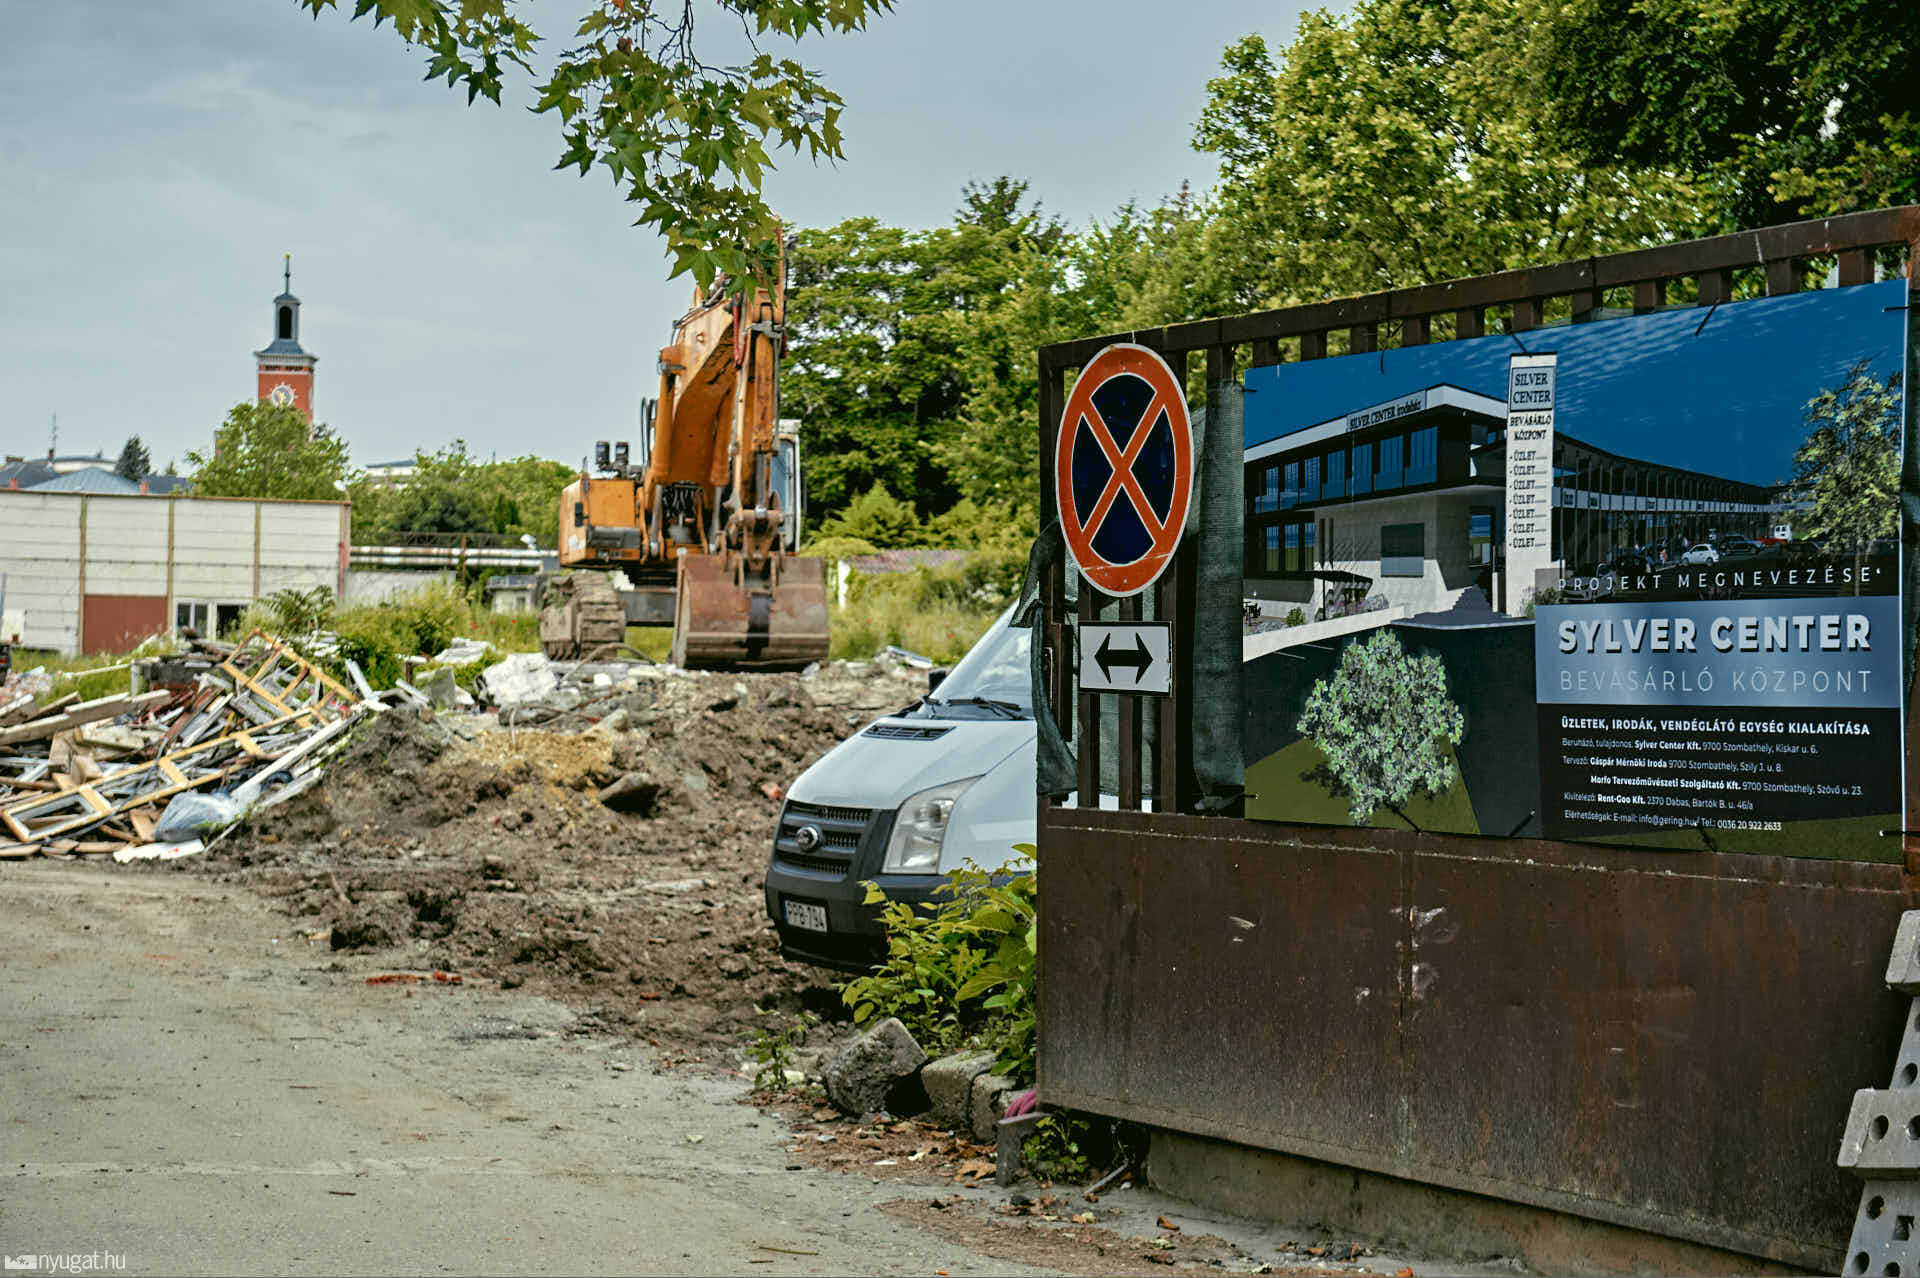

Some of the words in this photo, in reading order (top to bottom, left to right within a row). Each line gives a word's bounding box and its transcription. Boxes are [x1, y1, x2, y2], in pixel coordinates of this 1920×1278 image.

[1515, 373, 1548, 386] SILVER
[1513, 390, 1551, 404] CENTER
[1371, 406, 1396, 424] CENTER
[1558, 574, 1662, 591] PROJEKT
[1558, 618, 1696, 654] SYLVER
[1710, 614, 1872, 653] CENTER
[1733, 666, 1872, 692] KÖZPONT
[1562, 716, 1609, 730] ÜZLETEK,
[1612, 717, 1656, 732] IRODÁK,
[1660, 718, 1735, 732] VENDÉGLÁTÓ
[1740, 720, 1784, 733] EGYSÉG
[1788, 720, 1870, 734] KIALAKÍTÁSA
[1634, 740, 1657, 750] Sylver
[1659, 740, 1685, 750] Center
[1687, 740, 1702, 750] Kft.
[1702, 742, 1721, 751] 9700
[1723, 742, 1774, 754] Szombathely,
[1802, 746, 1809, 754] u.
[1810, 745, 1818, 754] 6.
[1590, 757, 1614, 768] Gáspár
[1616, 758, 1646, 768] Mérnöki
[1648, 760, 1667, 768] Iroda
[1669, 760, 1688, 769] 9700
[1688, 760, 1739, 772] Szombathely,
[1767, 764, 1774, 772] u.
[1776, 764, 1784, 772] 8.
[1590, 776, 1611, 784] Morfo
[1680, 779, 1724, 790] Szolgáltató
[1726, 780, 1741, 790] Kft.
[1742, 782, 1762, 791] 9700
[1763, 782, 1815, 795] Szombathely,
[1842, 786, 1850, 794] u.
[1851, 786, 1864, 796] 23.
[1632, 796, 1646, 804] Kft.
[1648, 796, 1664, 805] 2370
[1666, 797, 1690, 808] Dabas,
[1720, 800, 1726, 808] B.
[1717, 820, 1736, 829] 0036
[1738, 820, 1748, 830] 20
[1748, 821, 1762, 830] 922
[1763, 822, 1782, 831] 2633
